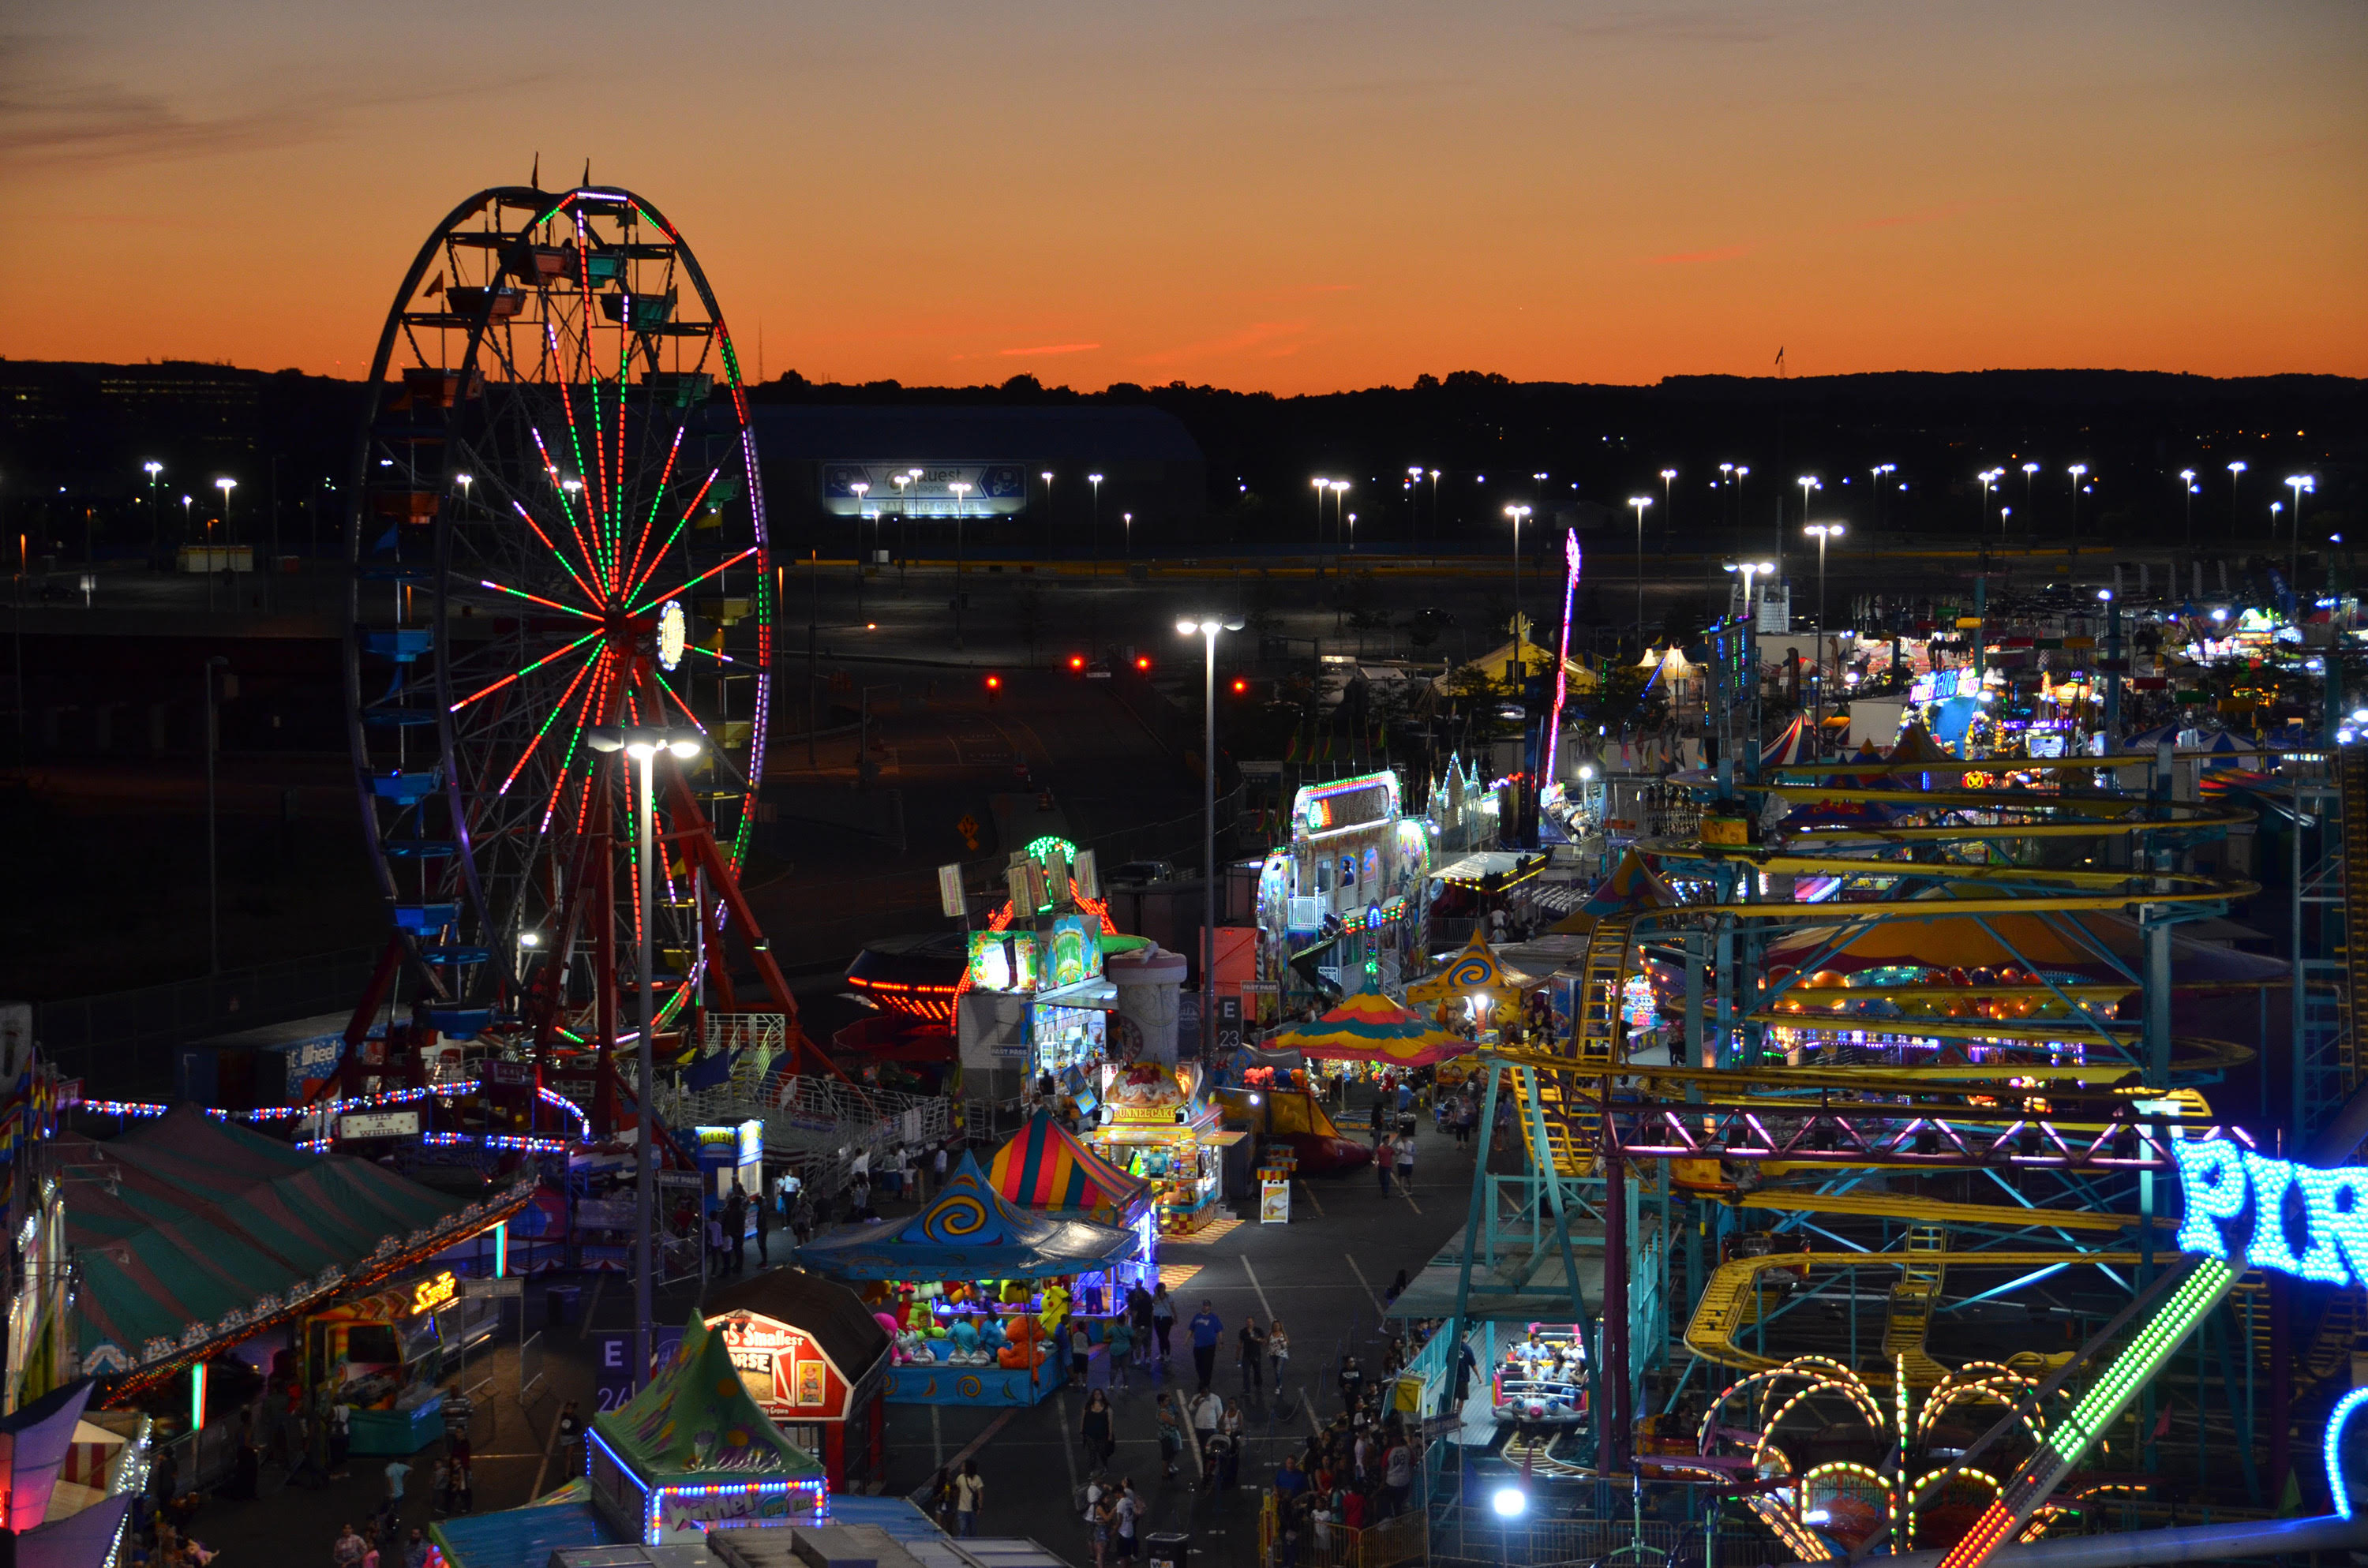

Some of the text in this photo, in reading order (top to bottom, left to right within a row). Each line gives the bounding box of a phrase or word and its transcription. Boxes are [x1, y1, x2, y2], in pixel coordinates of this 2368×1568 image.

[871, 502, 980, 511] TRAINING CENTER
[1936, 670, 1958, 697] BIG
[1223, 1001, 1235, 1018] E
[1220, 1030, 1239, 1047] 23
[302, 1039, 338, 1066] Wheel
[1151, 1108, 1175, 1117] CAKE
[360, 1128, 403, 1136] WHIRL
[699, 1130, 735, 1147] TICKETS
[743, 1322, 805, 1346] Smallest
[605, 1340, 623, 1367] E
[770, 1406, 789, 1415] Grown
[669, 1491, 759, 1532] Winner
